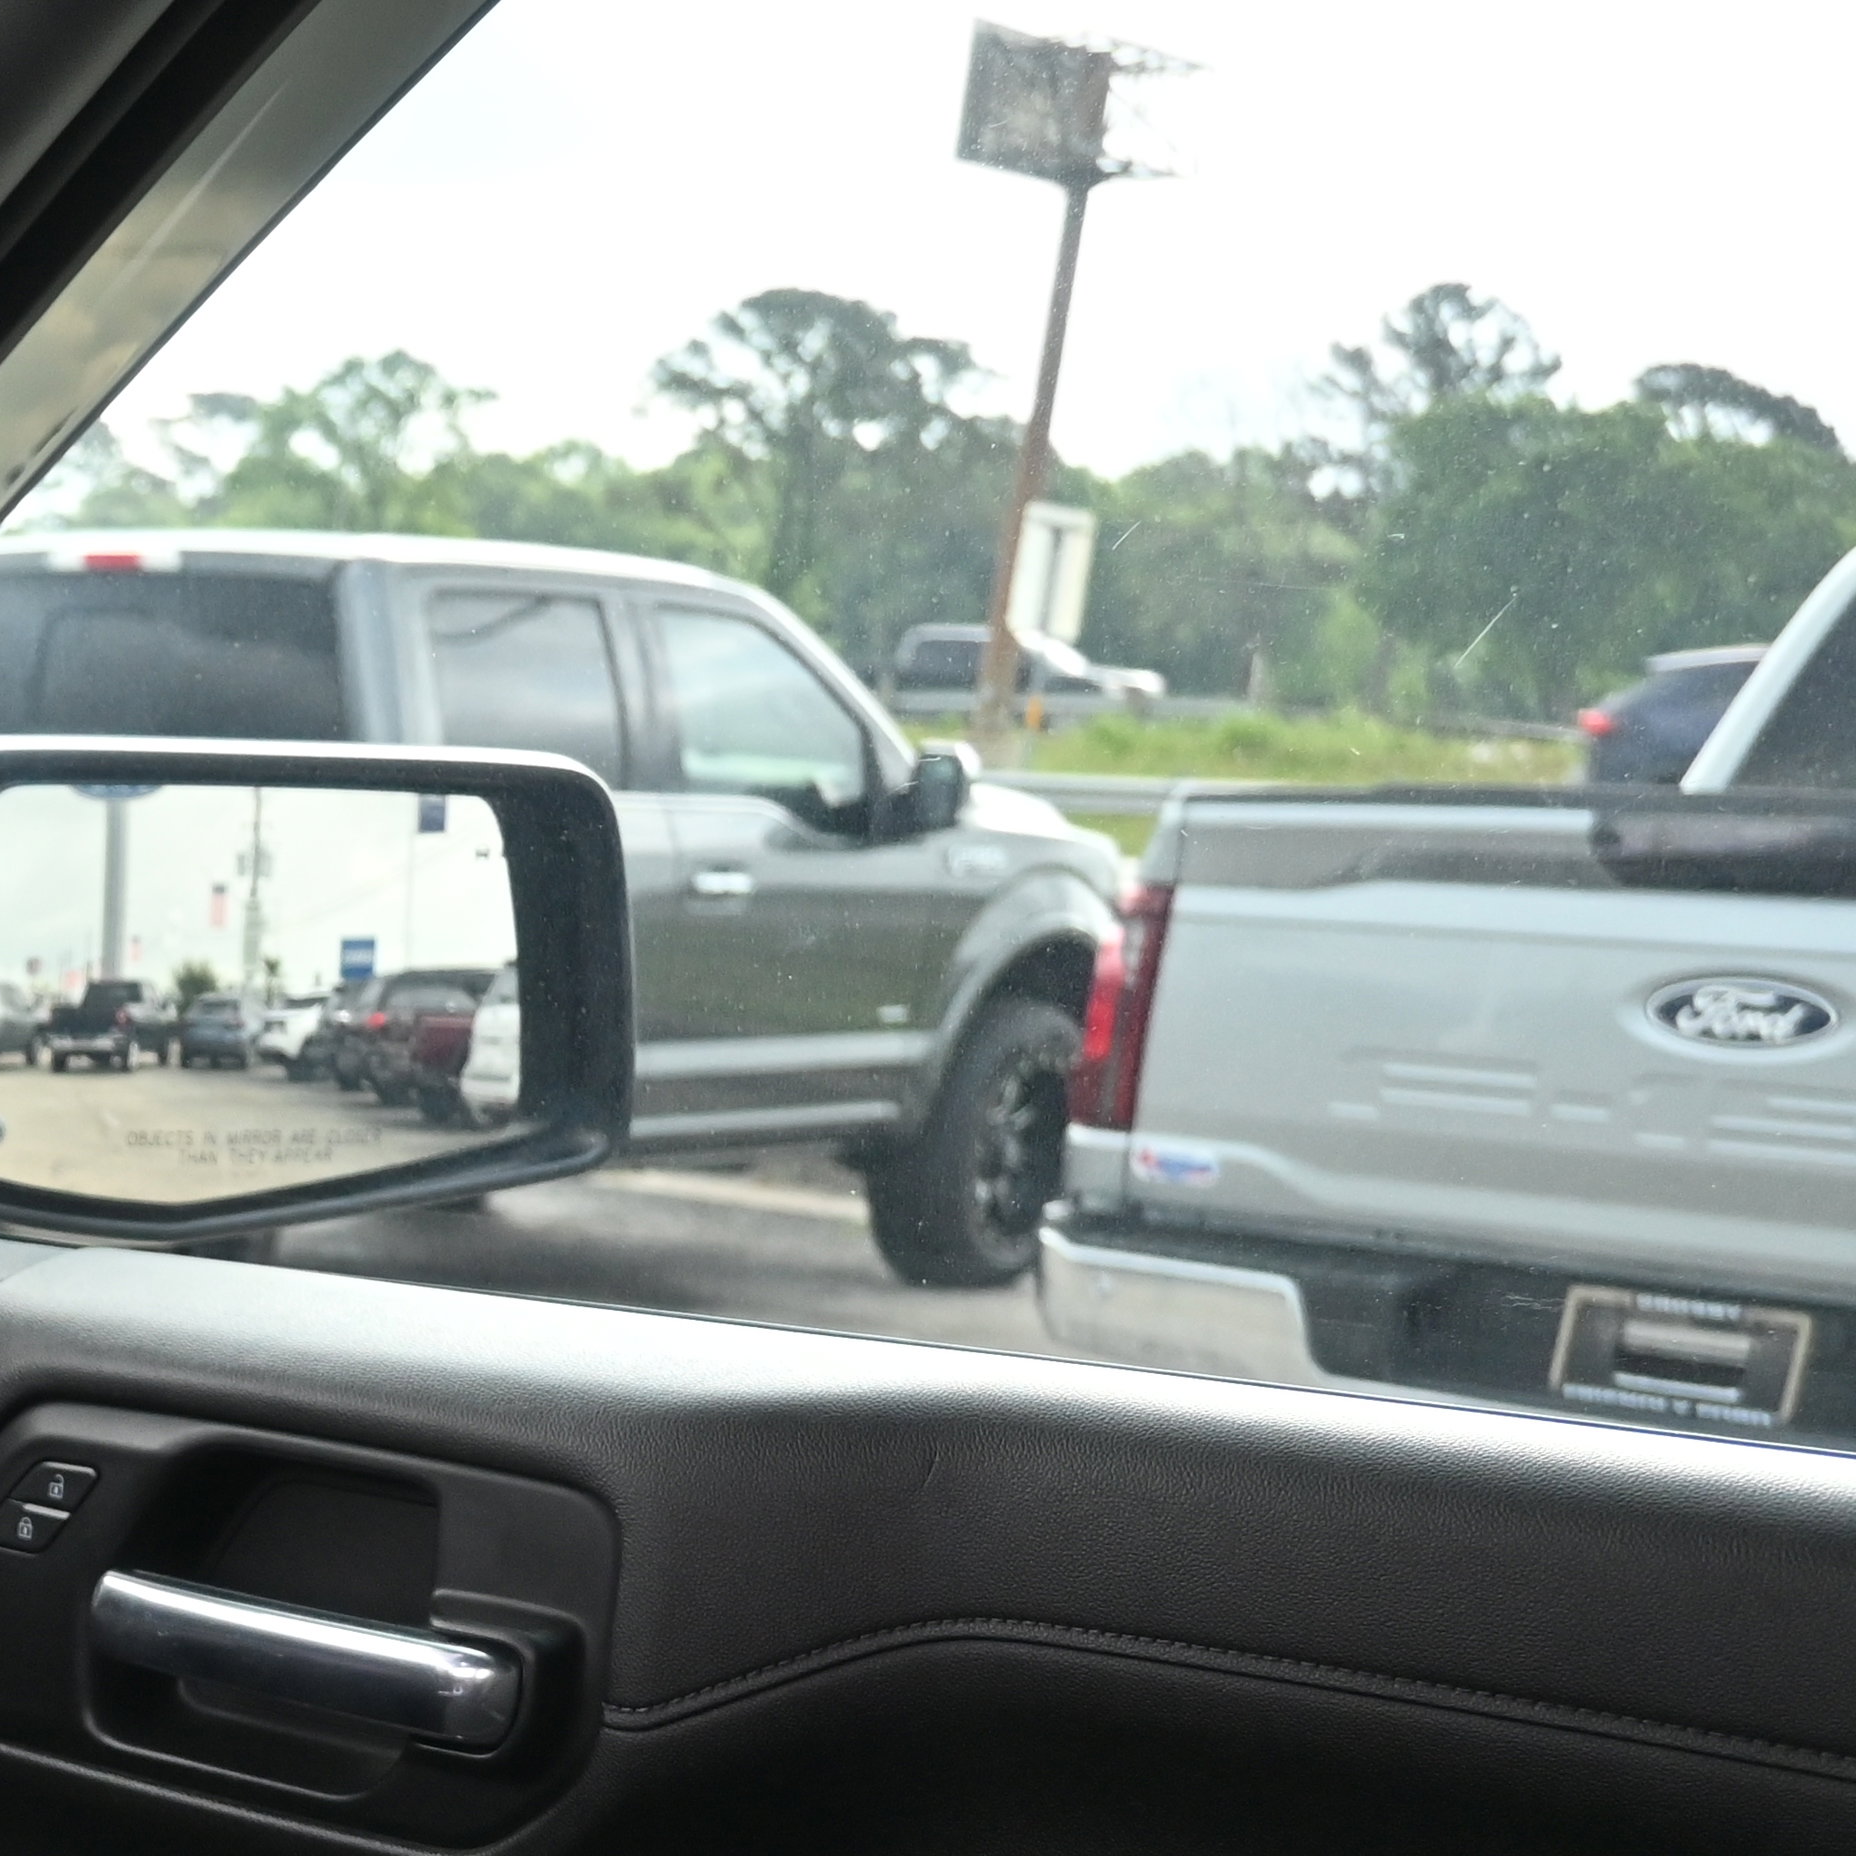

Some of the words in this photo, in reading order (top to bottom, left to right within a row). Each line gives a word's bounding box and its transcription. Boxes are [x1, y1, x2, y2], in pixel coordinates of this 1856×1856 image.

[1675, 983, 1806, 1046] Ford
[126, 1130, 194, 1147] OBJECTS
[203, 1130, 216, 1146] IN
[226, 1129, 282, 1146] MIRROR
[291, 1129, 315, 1145] ARE
[230, 1148, 266, 1165] THEY
